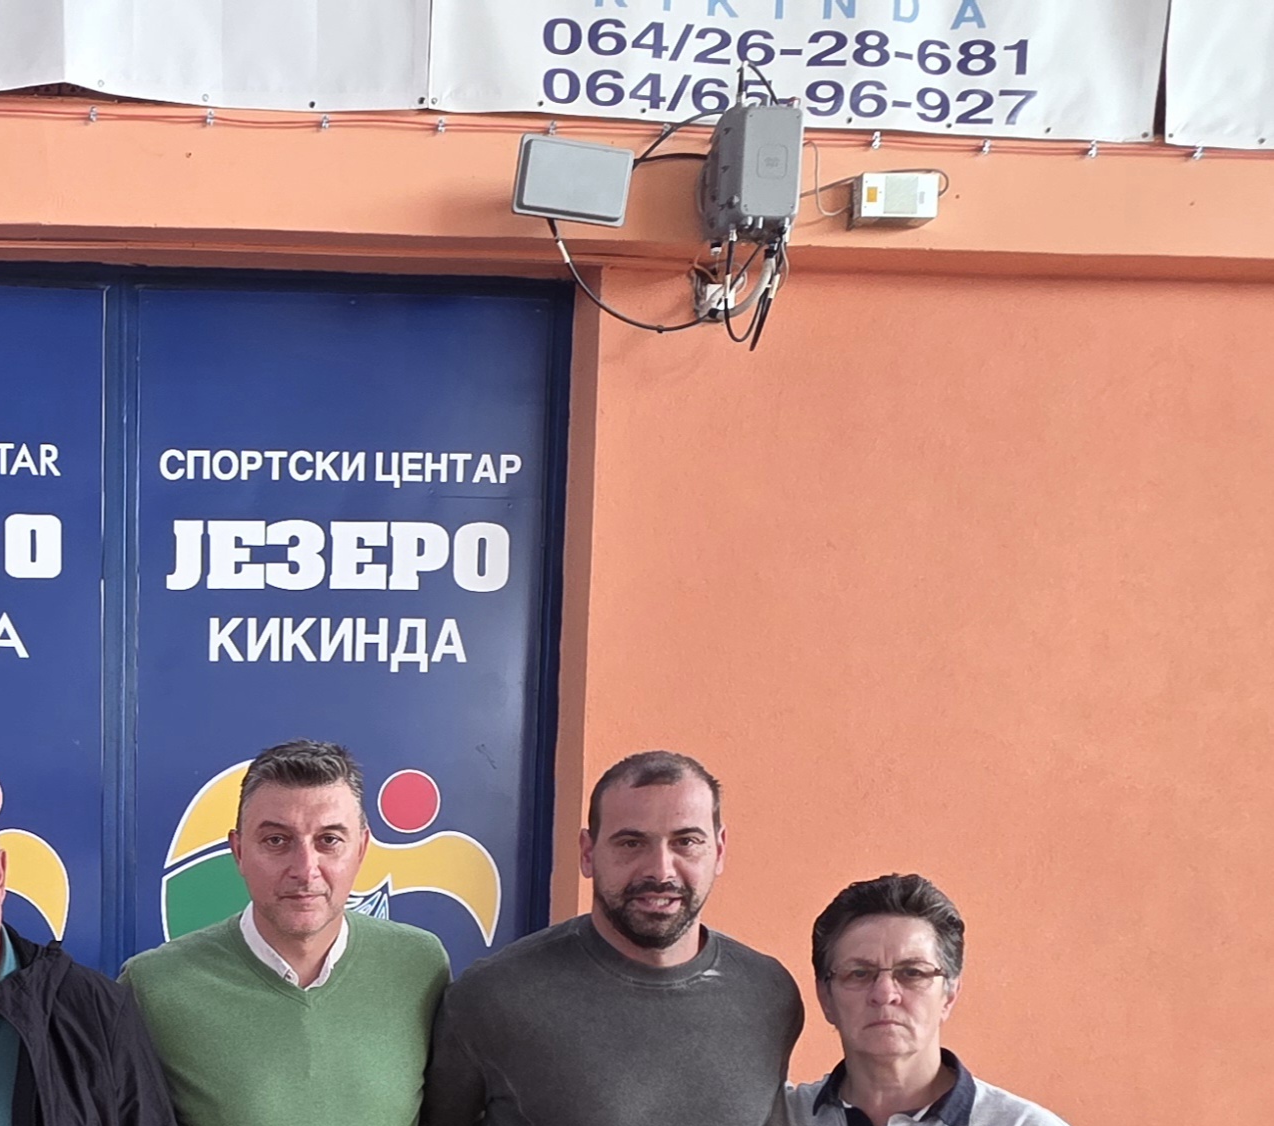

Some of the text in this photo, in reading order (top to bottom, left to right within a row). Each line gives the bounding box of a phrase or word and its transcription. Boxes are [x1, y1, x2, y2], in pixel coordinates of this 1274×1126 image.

[594, 0, 987, 30] KINDA
[542, 18, 1029, 76] 064/26-28-681
[159, 448, 523, 489] СПОРТСКИ ЦЕНТАР
[165, 519, 511, 593] ЈЕЗЕРО
[208, 616, 467, 673] КИКИНДА
